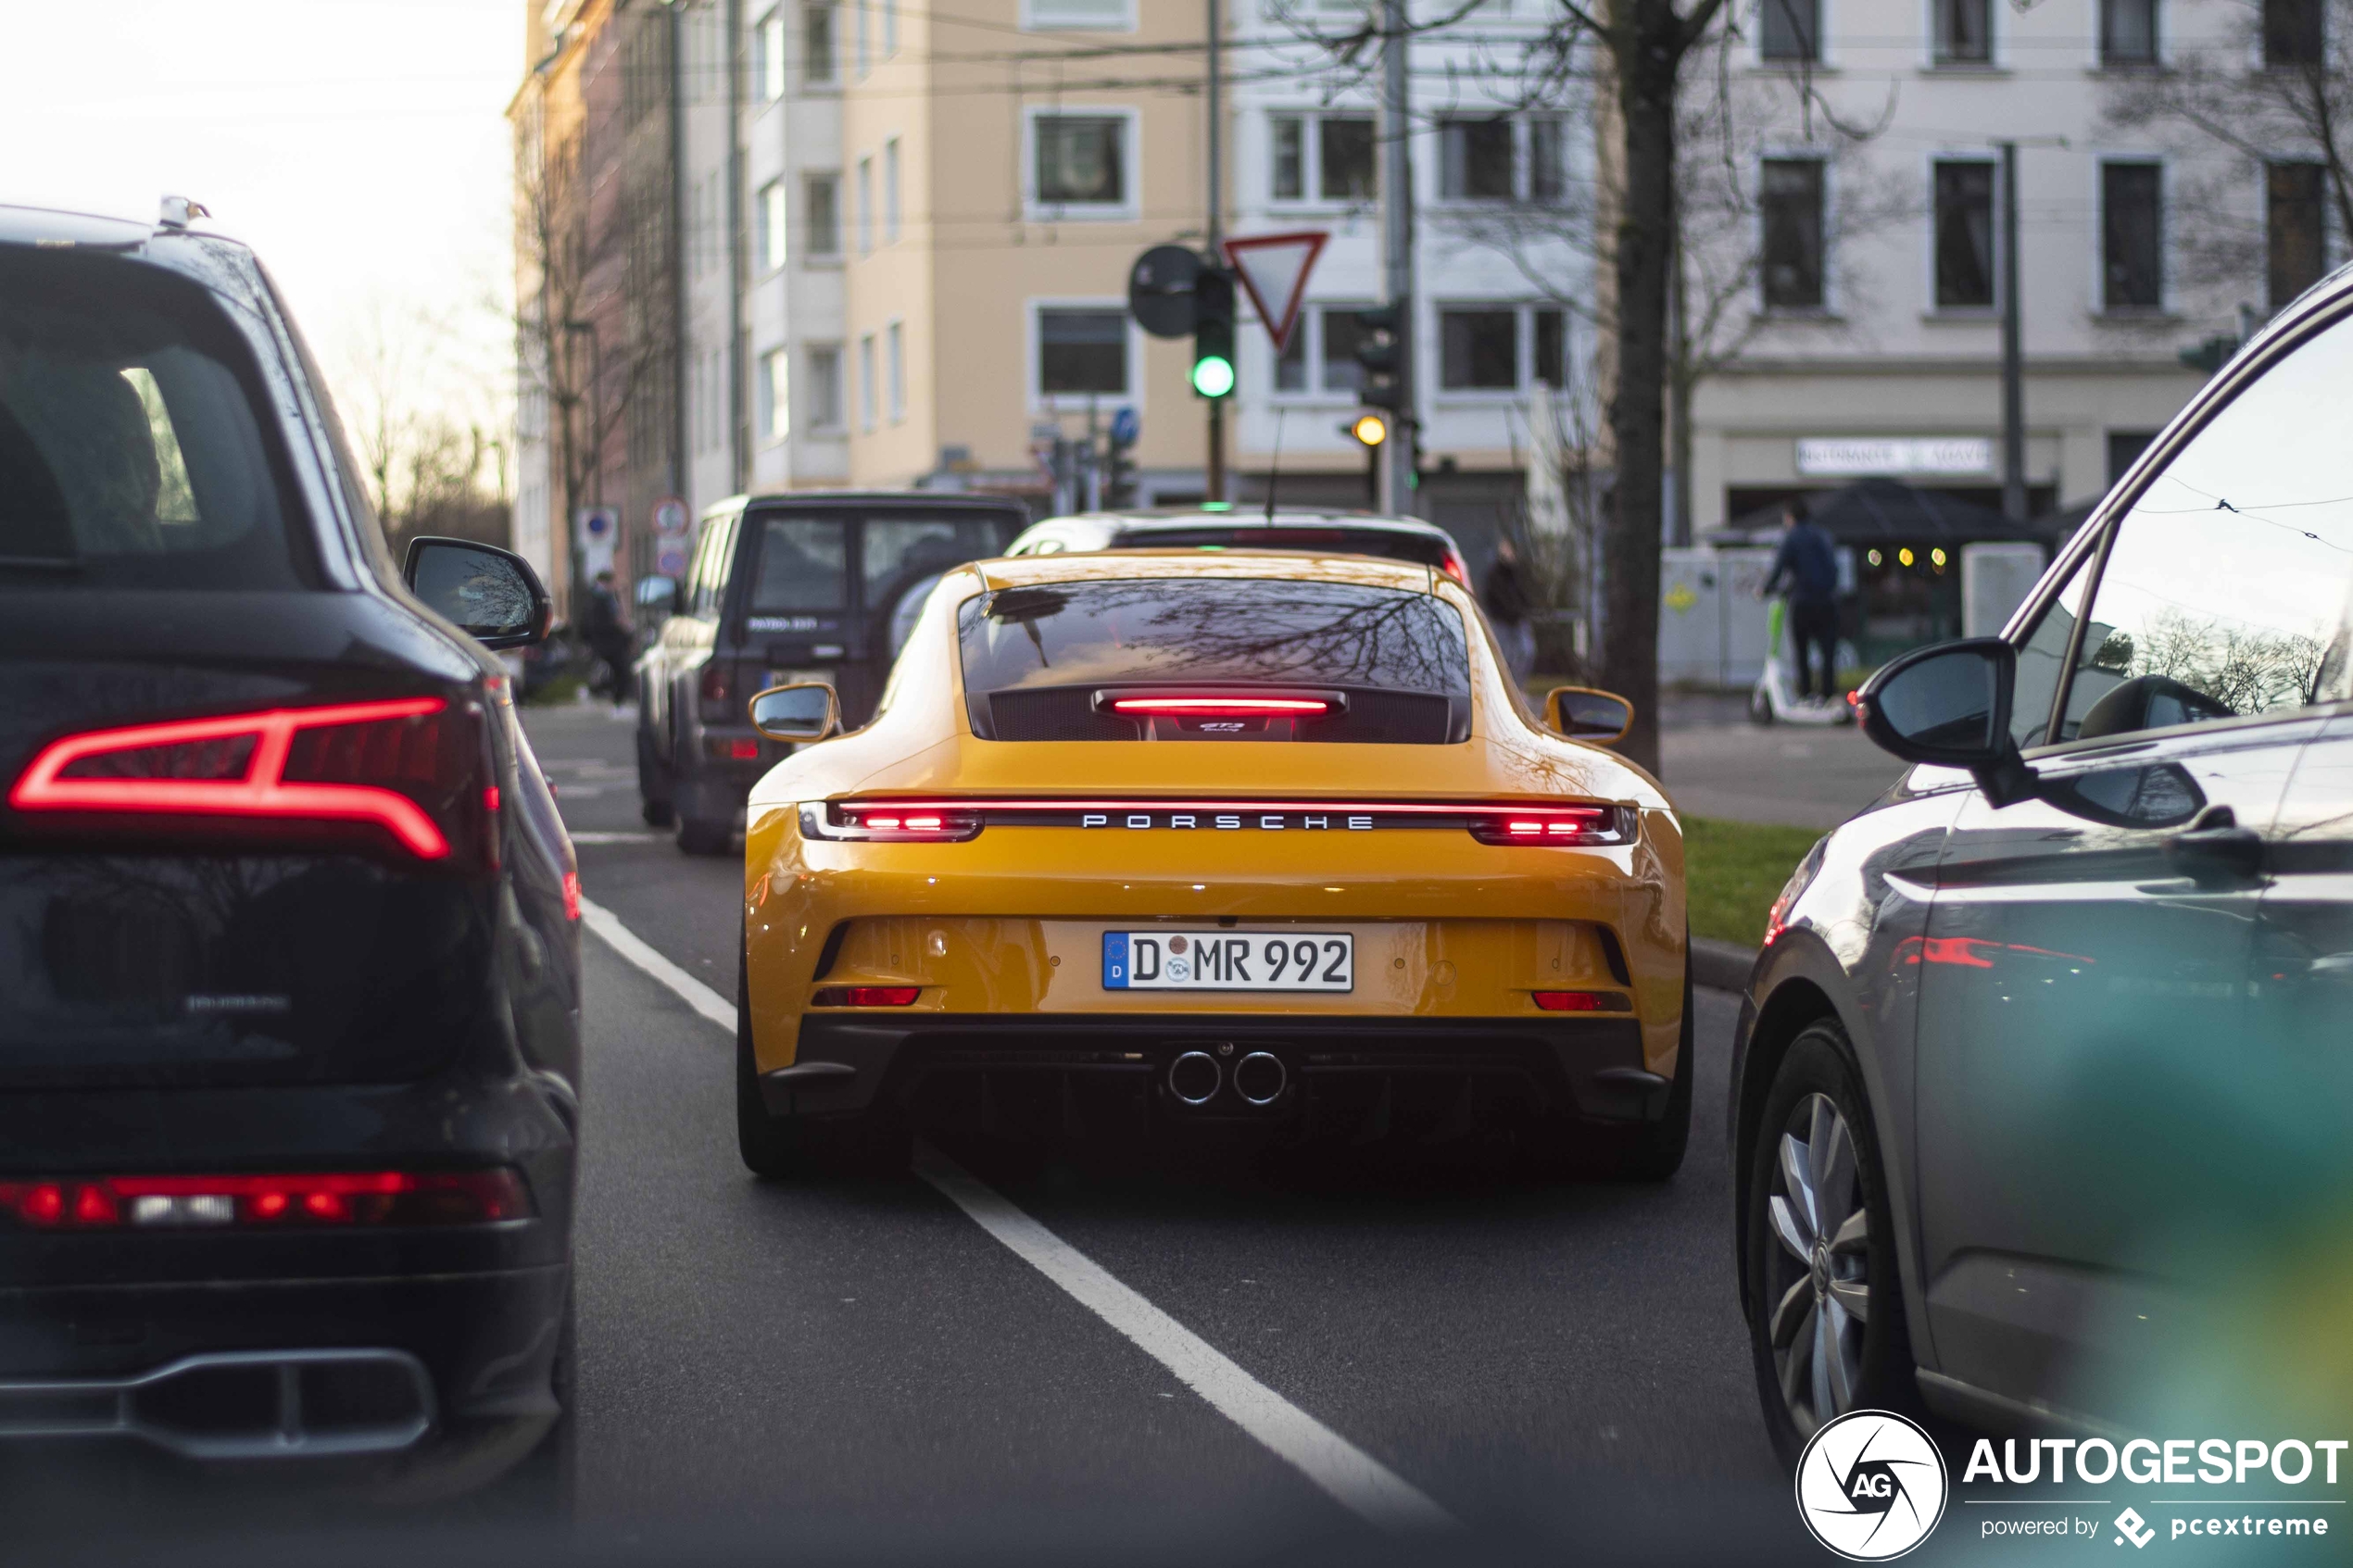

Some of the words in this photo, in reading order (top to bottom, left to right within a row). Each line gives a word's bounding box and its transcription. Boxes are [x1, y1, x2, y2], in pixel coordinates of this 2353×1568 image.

[1083, 815, 1373, 830] PORSCHE
[1133, 939, 1160, 981] D
[1194, 939, 1252, 982] MR
[1264, 940, 1348, 983] 992
[1113, 965, 1122, 978] D
